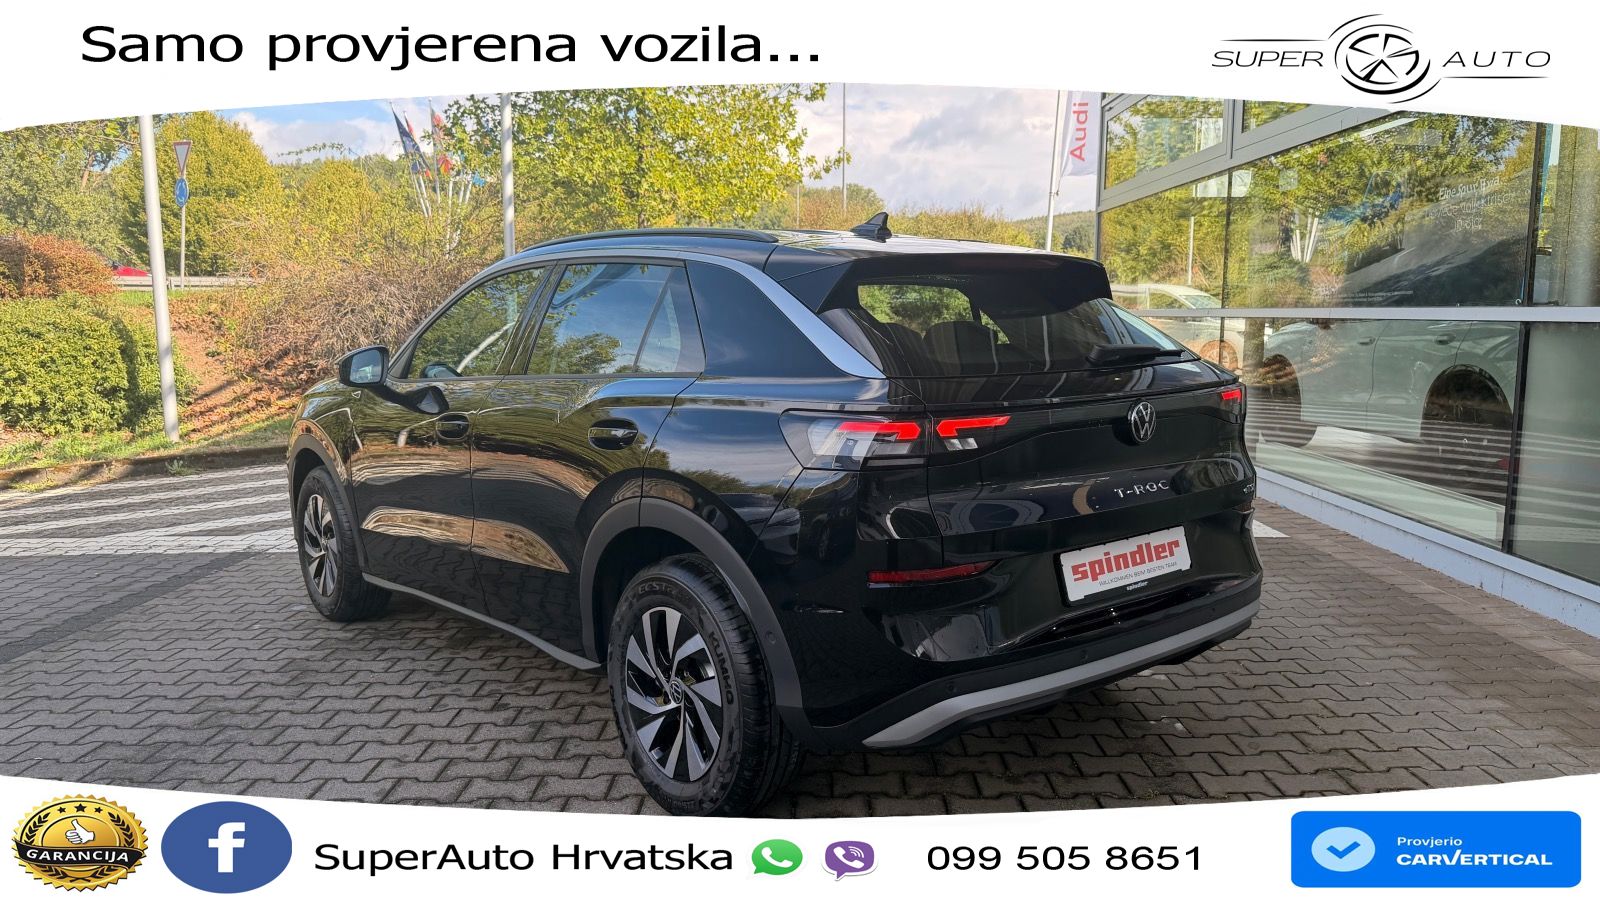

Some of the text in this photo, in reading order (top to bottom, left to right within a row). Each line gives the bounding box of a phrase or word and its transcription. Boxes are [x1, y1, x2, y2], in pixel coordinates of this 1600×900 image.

[1069, 102, 1089, 162] Audi
[1114, 480, 1170, 498] T-ROC
[1071, 539, 1181, 582] spindler
